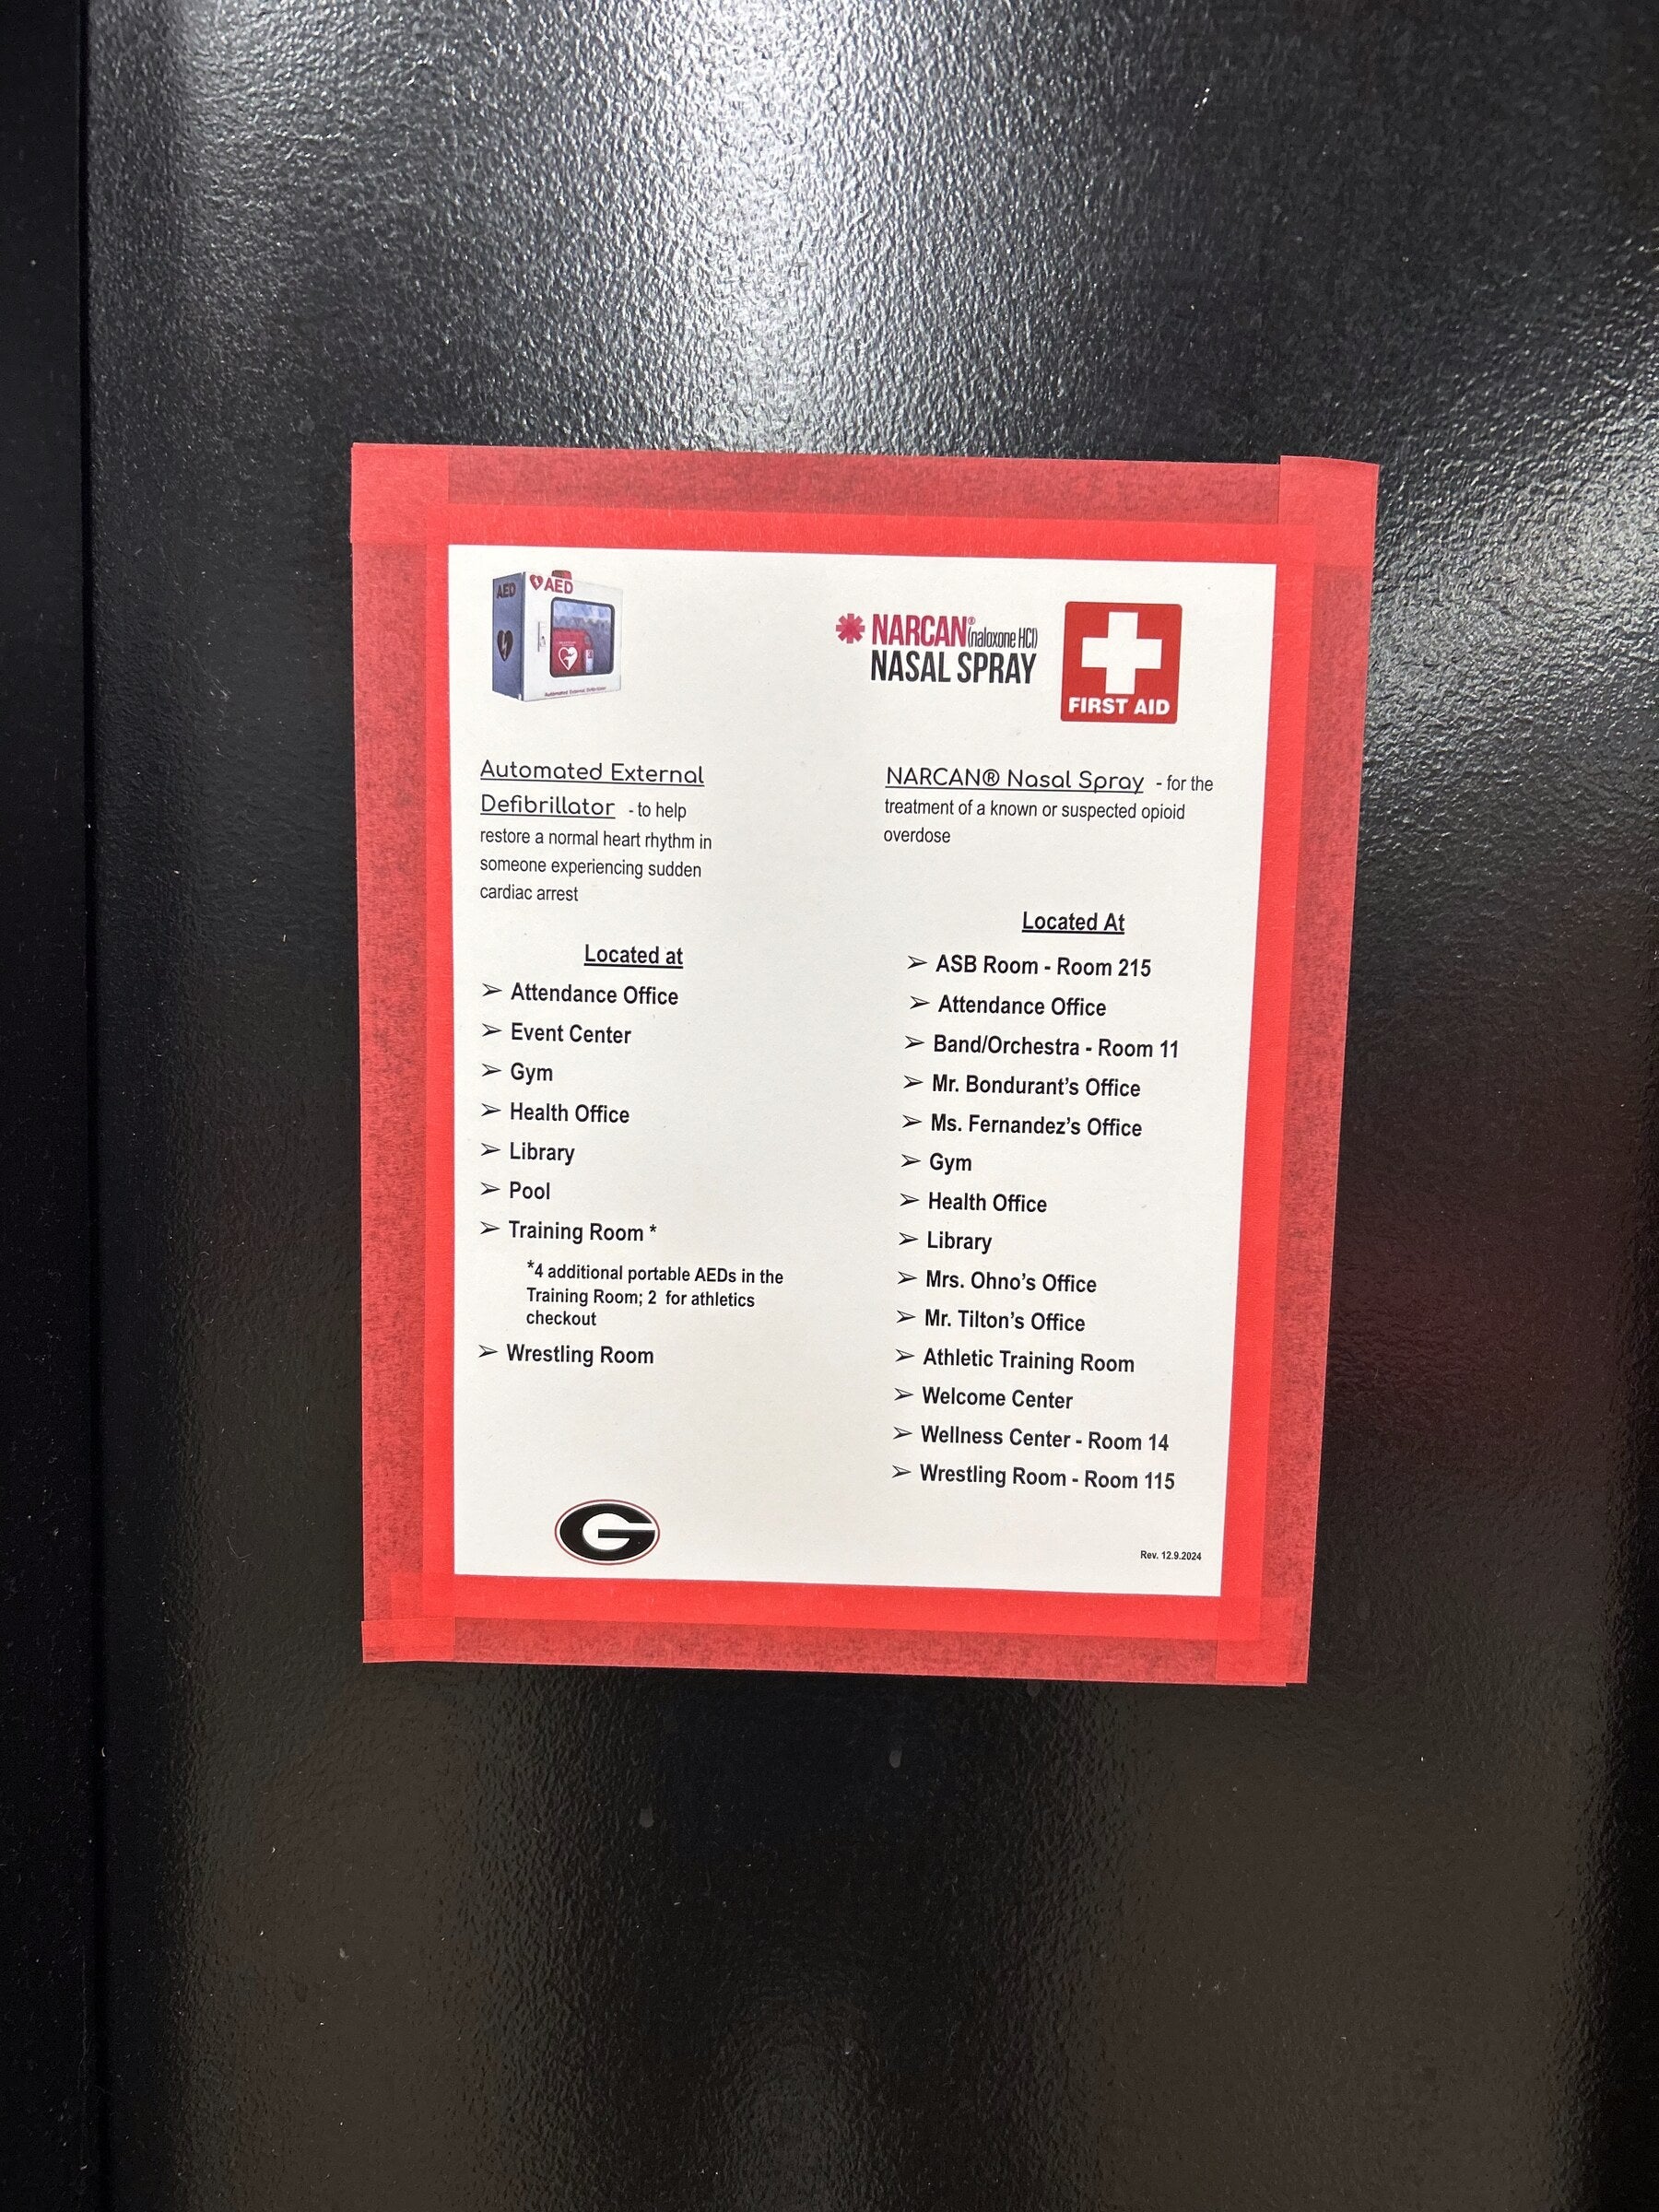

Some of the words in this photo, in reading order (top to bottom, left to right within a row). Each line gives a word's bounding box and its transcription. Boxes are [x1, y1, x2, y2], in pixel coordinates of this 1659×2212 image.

[496, 582, 516, 598] AED
[544, 578, 573, 594] AED
[968, 627, 1016, 648] (naloxone
[871, 650, 951, 682] NASAL
[957, 652, 1038, 684] SPRAY
[1068, 697, 1129, 715] FIRST
[1134, 698, 1171, 716] AID
[480, 759, 603, 783] Automated
[611, 762, 705, 785] External
[886, 767, 1000, 790] NARCAN®
[1007, 769, 1072, 791] Nasal
[1078, 771, 1144, 794] Spray
[1167, 775, 1186, 791] for
[1191, 775, 1213, 792] the
[480, 794, 616, 818] Defibrillator
[638, 802, 651, 818] to
[656, 802, 687, 822] help
[885, 798, 954, 815] treatment
[959, 799, 973, 815] of
[977, 804, 985, 816] a
[991, 800, 1038, 817] known
[1042, 805, 1057, 817] or
[1062, 803, 1136, 821] suspected
[1142, 804, 1185, 823] opioid
[481, 829, 531, 843] restore
[535, 832, 544, 843] a
[549, 830, 598, 845] normal
[604, 830, 641, 847] heart
[645, 832, 694, 852] rhythm
[700, 833, 712, 850] in
[884, 827, 950, 843] overdose
[480, 859, 547, 872] someone
[551, 858, 642, 879] experiencing
[649, 861, 701, 877] sudden
[480, 884, 532, 900] cardiac
[536, 887, 578, 901] arrest
[1021, 912, 1098, 931] Located
[1103, 912, 1125, 933] At
[583, 944, 659, 965] Located
[665, 947, 684, 966] at
[935, 954, 977, 972] ASB
[983, 956, 1038, 974] Room
[1057, 957, 1112, 976] Room
[1118, 959, 1151, 977] 215
[511, 982, 617, 1004] Attendance
[624, 985, 678, 1005] Office
[938, 994, 1044, 1015] Attendance
[1052, 997, 1106, 1017] Office
[512, 1022, 563, 1041] Event
[570, 1024, 631, 1043] Center
[934, 1034, 1079, 1055] Band/Orchestra
[1099, 1039, 1153, 1057] Room
[1160, 1040, 1179, 1058] 11
[511, 1062, 553, 1086] Gym
[933, 1074, 959, 1092] Mr.
[1086, 1077, 1140, 1097] Office
[511, 1102, 568, 1122] Health
[575, 1104, 629, 1124] Office
[931, 1113, 962, 1132] Ms.
[1088, 1118, 1142, 1136] Office
[511, 1142, 575, 1166] Library
[930, 1152, 971, 1175] Gym
[510, 1181, 550, 1199] Pool
[929, 1192, 986, 1211] Health
[993, 1194, 1047, 1213] Office
[509, 1220, 582, 1244] Training
[590, 1223, 643, 1241] Room
[927, 1230, 993, 1254] Library
[548, 1264, 623, 1280] additional
[629, 1266, 690, 1284] portable
[694, 1267, 736, 1283] AEDs
[742, 1268, 755, 1283] in
[759, 1269, 783, 1284] the
[926, 1270, 965, 1288] Mrs.
[1042, 1274, 1097, 1293] Office
[526, 1287, 588, 1307] Training
[594, 1288, 643, 1307] Room;
[648, 1290, 657, 1305] 2
[665, 1290, 687, 1305] for
[691, 1291, 755, 1307] athletics
[526, 1310, 596, 1325] checkout
[925, 1309, 951, 1326] Mr.
[1031, 1312, 1085, 1332] Office
[507, 1344, 594, 1367] Wrestling
[601, 1346, 653, 1364] Room
[923, 1347, 994, 1367] Athletic
[999, 1350, 1074, 1375] Training
[1081, 1353, 1135, 1372] Room
[923, 1386, 1006, 1406] Welcome
[1012, 1389, 1073, 1409] Center
[921, 1425, 1003, 1445] Wellness
[1009, 1428, 1071, 1448] Center
[1088, 1431, 1142, 1450] Room
[1148, 1433, 1169, 1452] 14
[920, 1464, 1006, 1488] Wrestling
[1013, 1466, 1066, 1486] Room
[1085, 1470, 1137, 1488] Room
[1145, 1472, 1175, 1489] 115
[1140, 1550, 1159, 1559] Rev.
[1161, 1551, 1202, 1561] 12.9.2024
